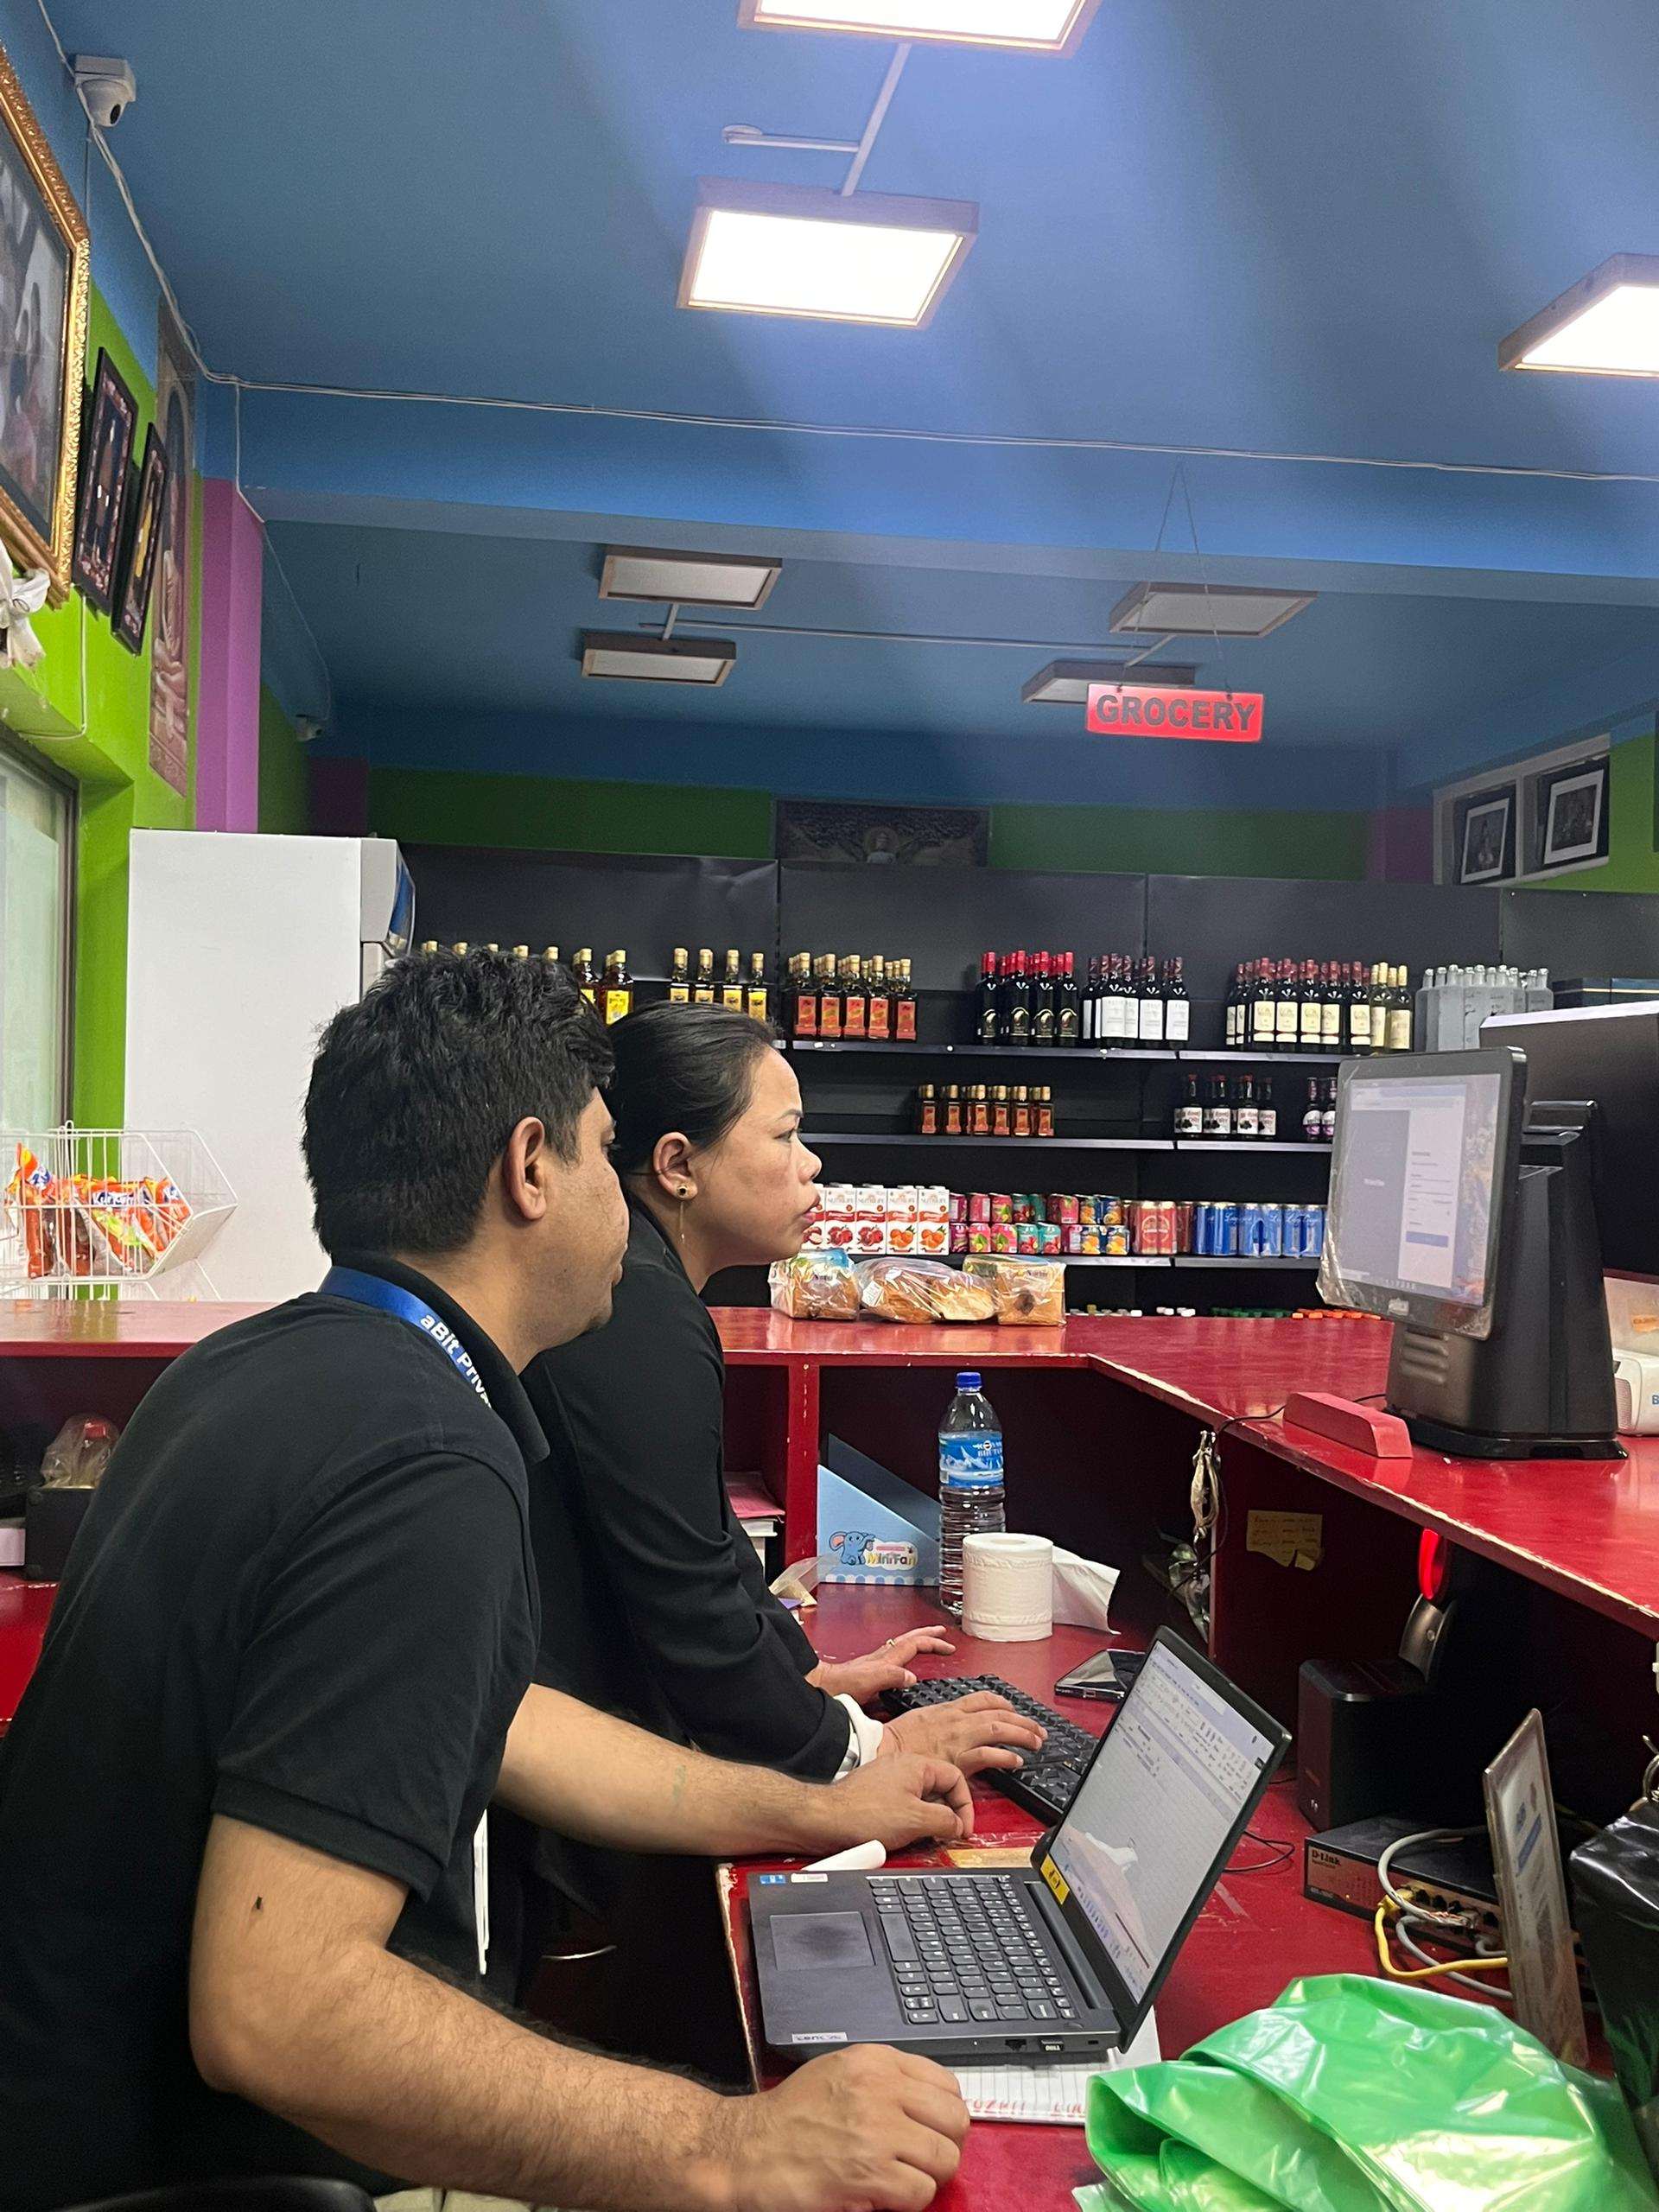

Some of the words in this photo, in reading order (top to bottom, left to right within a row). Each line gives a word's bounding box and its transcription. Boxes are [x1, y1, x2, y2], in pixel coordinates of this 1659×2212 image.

[1096, 694, 1255, 731] GROCERY
[420, 1314, 460, 1355] aBit
[456, 1351, 493, 1409] Priva
[1311, 1849, 1341, 1866] D-Link
